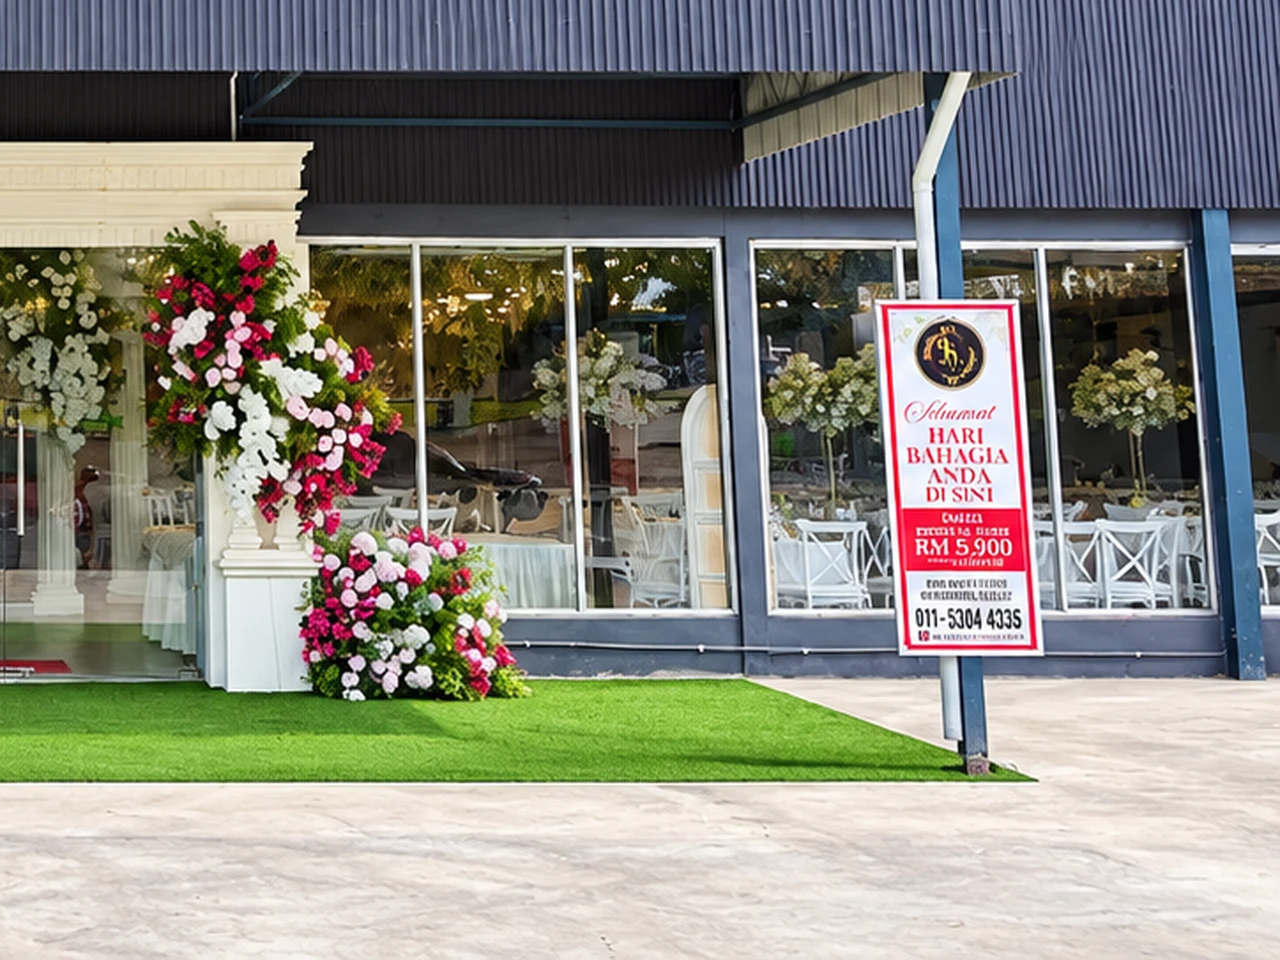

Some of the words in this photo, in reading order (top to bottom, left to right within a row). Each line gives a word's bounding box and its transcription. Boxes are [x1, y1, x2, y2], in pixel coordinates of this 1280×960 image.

[929, 428, 983, 444] HARI
[907, 447, 1008, 464] BAHAGIA
[928, 468, 991, 484] ANDA
[926, 487, 945, 503] DI
[952, 487, 993, 503] SINI
[915, 539, 949, 556] RM
[915, 608, 982, 629] 011-5304
[986, 608, 1022, 629] 4335
